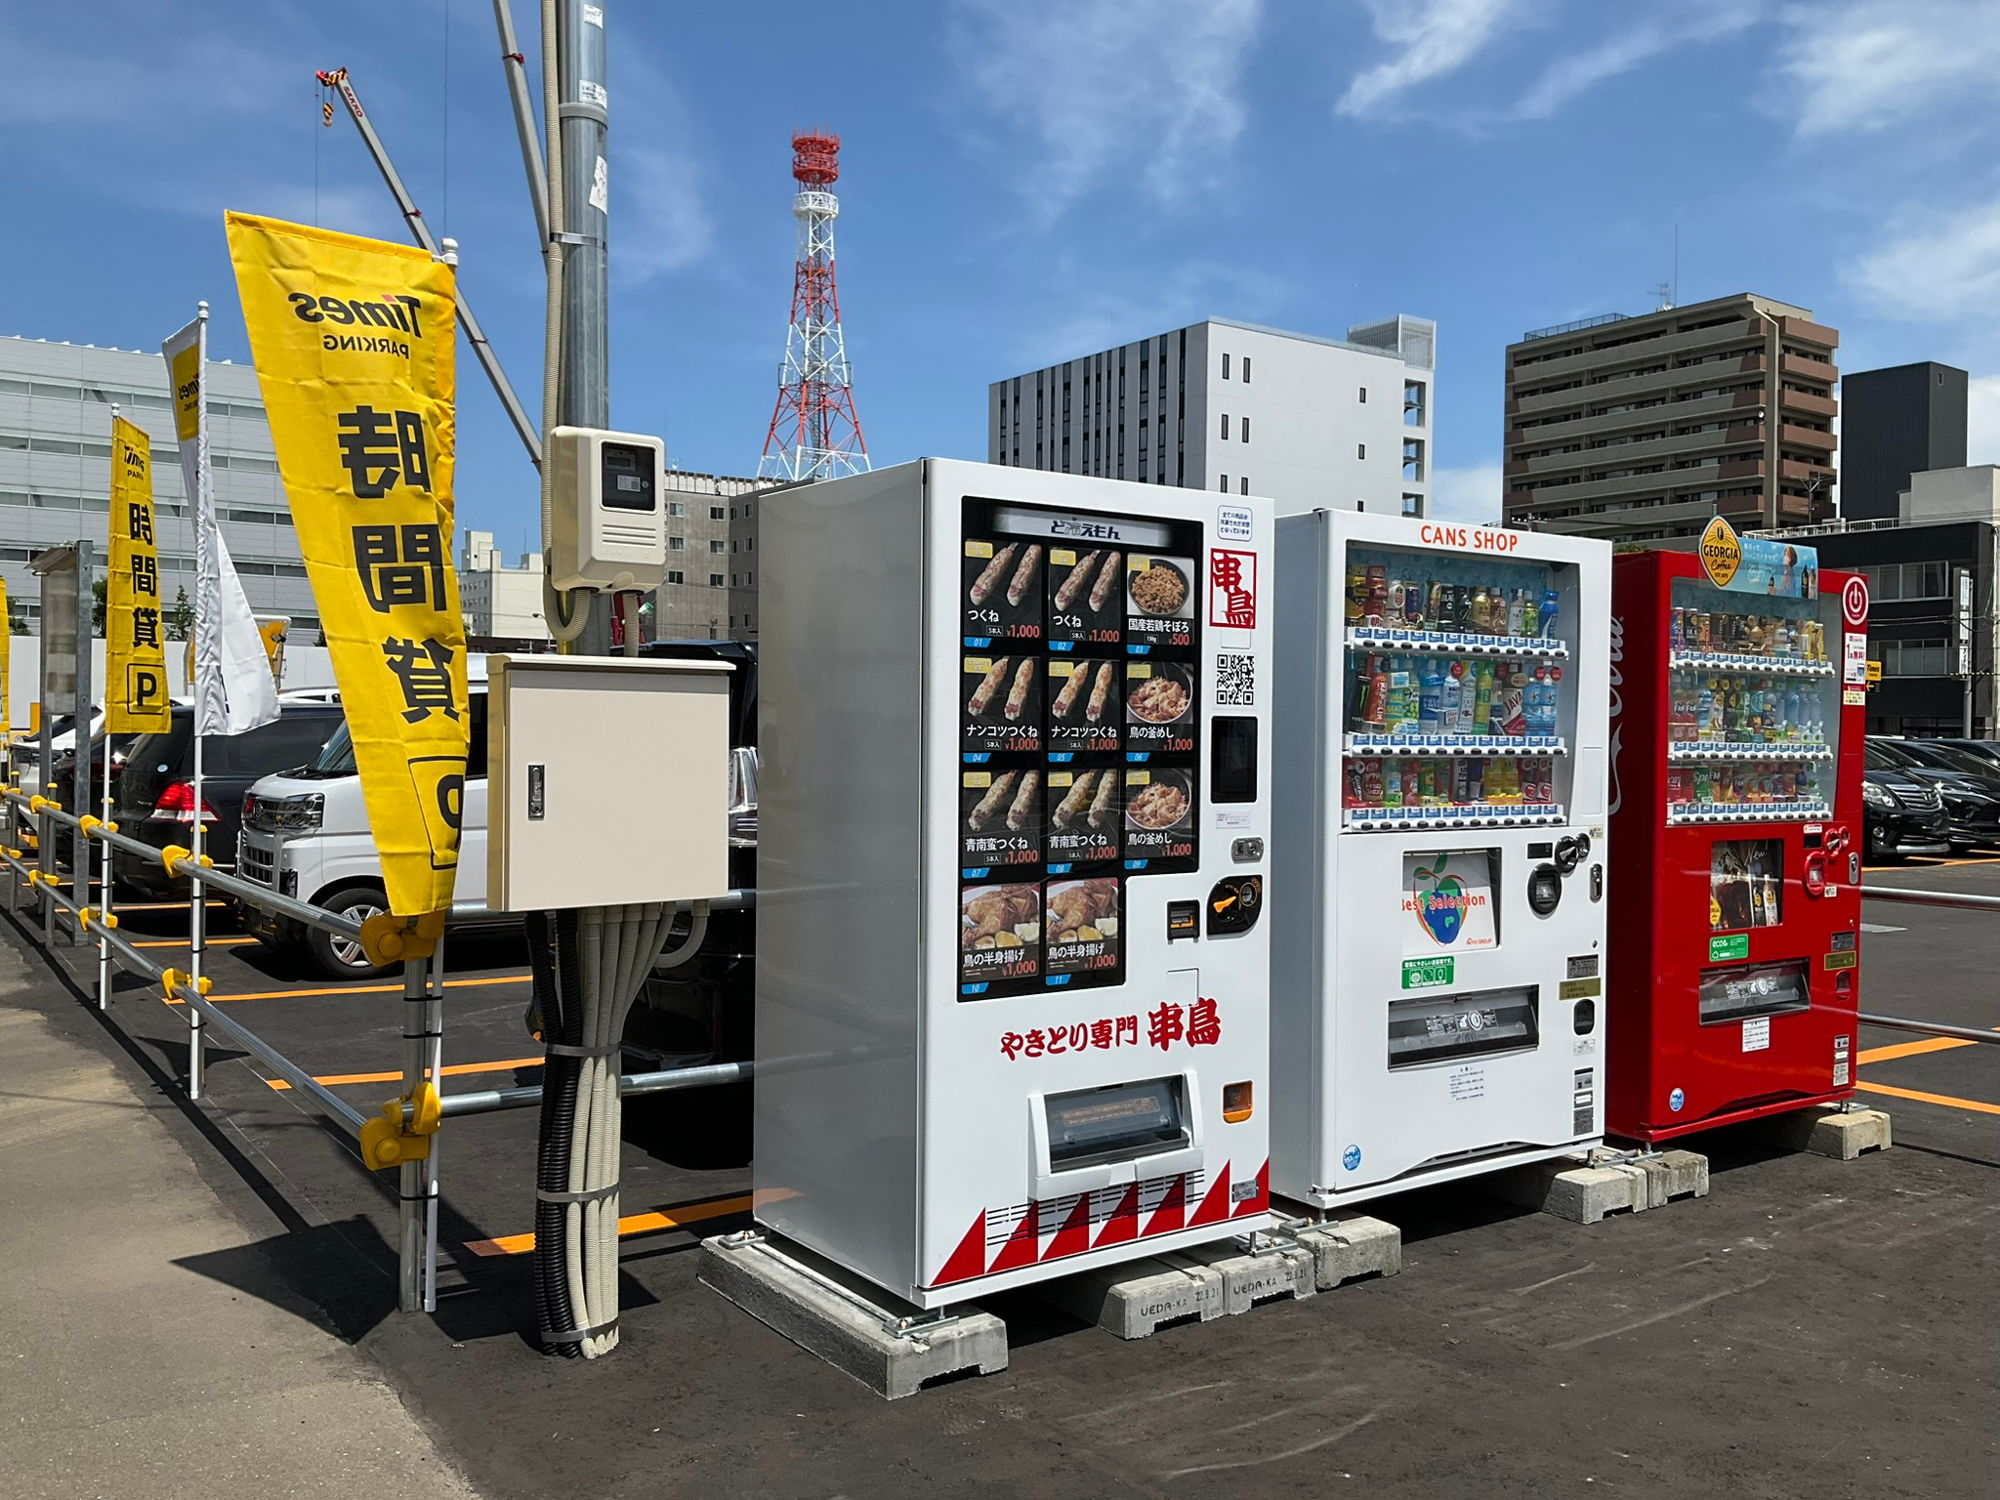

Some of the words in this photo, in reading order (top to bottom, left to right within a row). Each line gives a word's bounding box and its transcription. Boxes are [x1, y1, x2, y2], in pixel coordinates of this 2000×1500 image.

[1421, 525, 1466, 547] CANS
[1474, 530, 1518, 551] SHOP
[1704, 544, 1738, 560] GEORGIA
[1711, 559, 1732, 570] Coffee
[1212, 552, 1254, 626] 串鳥
[968, 609, 999, 622] つくね
[1053, 615, 1082, 627] つくね
[1007, 625, 1040, 638] ¥1,000
[1128, 618, 1189, 633] 国産若鶏そぼろ
[974, 638, 982, 646] 01
[1089, 629, 1119, 642] ¥1,000
[1168, 634, 1189, 645] ¥500
[137, 672, 156, 706] P
[966, 725, 1038, 738] ナンコツつくね
[1051, 726, 1117, 738] ナンコツつくね
[1130, 726, 1174, 738] 鳥の釜めし
[1006, 737, 1038, 750] ¥1,000
[1087, 738, 1117, 750] ¥1,000
[1164, 738, 1192, 751] ¥1,000
[965, 838, 1028, 852] 青南蛮つくね
[1049, 834, 1107, 849] 青南蛮つくね
[1128, 832, 1172, 846] 鳥の釜めし
[1086, 846, 1116, 860] ¥1,000
[1162, 844, 1192, 856] ¥1,000
[1004, 850, 1039, 864] ¥1,000
[1056, 865, 1064, 873] 08
[1132, 860, 1140, 868] 09
[972, 869, 981, 877] 07
[1429, 893, 1485, 910] Selection
[964, 948, 1025, 968] 鳥の半身揚げ
[1048, 944, 1104, 960] 鳥の半身揚げ
[1003, 960, 1036, 976] ¥1,000
[1084, 954, 1116, 969] ¥1,000
[1000, 1015, 1138, 1062] やきとり専門
[1148, 997, 1221, 1052] 串鳥
[1141, 1299, 1187, 1316] UEDA-KA
